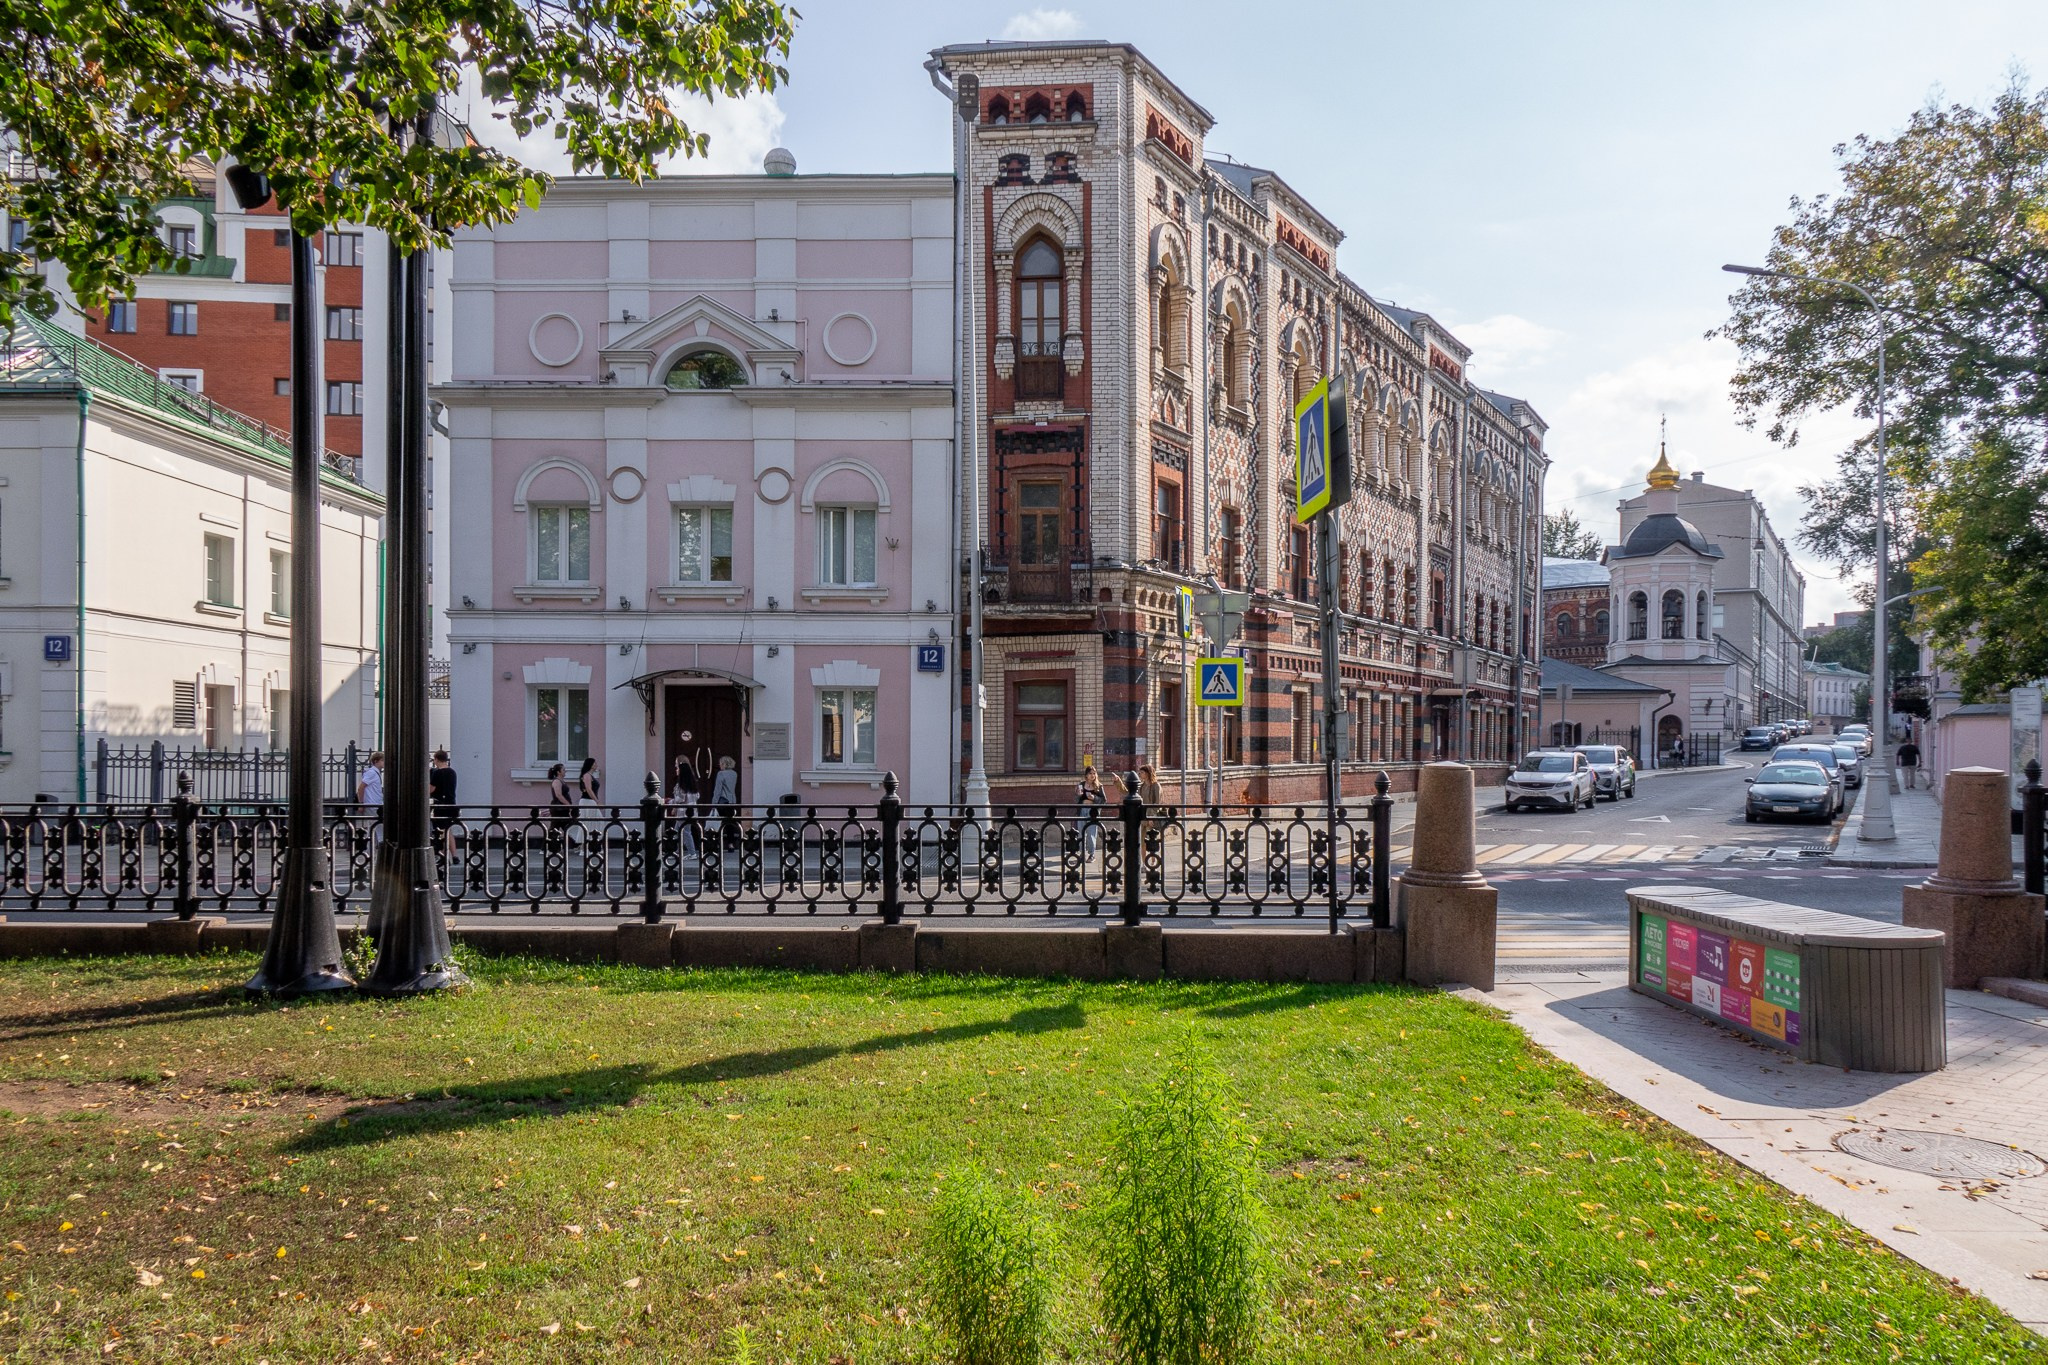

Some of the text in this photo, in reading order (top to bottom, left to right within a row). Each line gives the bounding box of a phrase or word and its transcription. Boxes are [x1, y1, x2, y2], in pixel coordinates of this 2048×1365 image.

[48, 640, 62, 652] 12
[923, 650, 938, 662] 12
[1644, 926, 1662, 942] ЛЕТО
